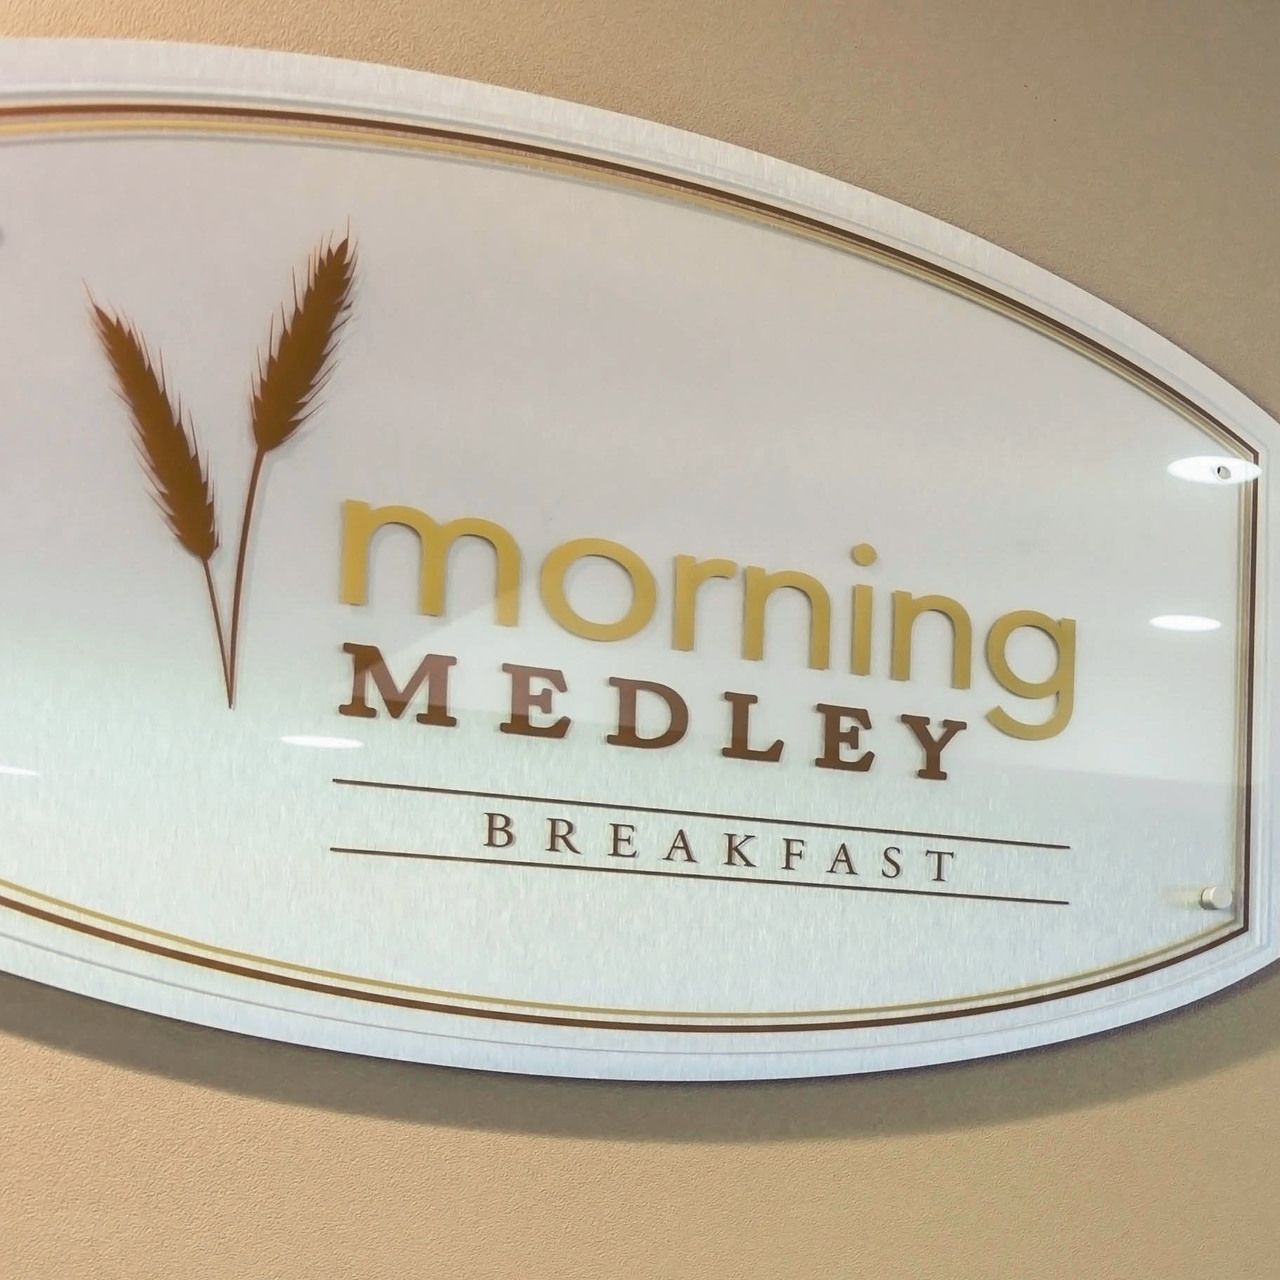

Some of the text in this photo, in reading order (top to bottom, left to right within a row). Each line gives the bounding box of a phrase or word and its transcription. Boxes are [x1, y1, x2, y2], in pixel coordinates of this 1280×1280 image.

[340, 498, 1078, 741] morning
[338, 642, 968, 781] MEDLEY
[483, 812, 957, 883] BREAKFAST
